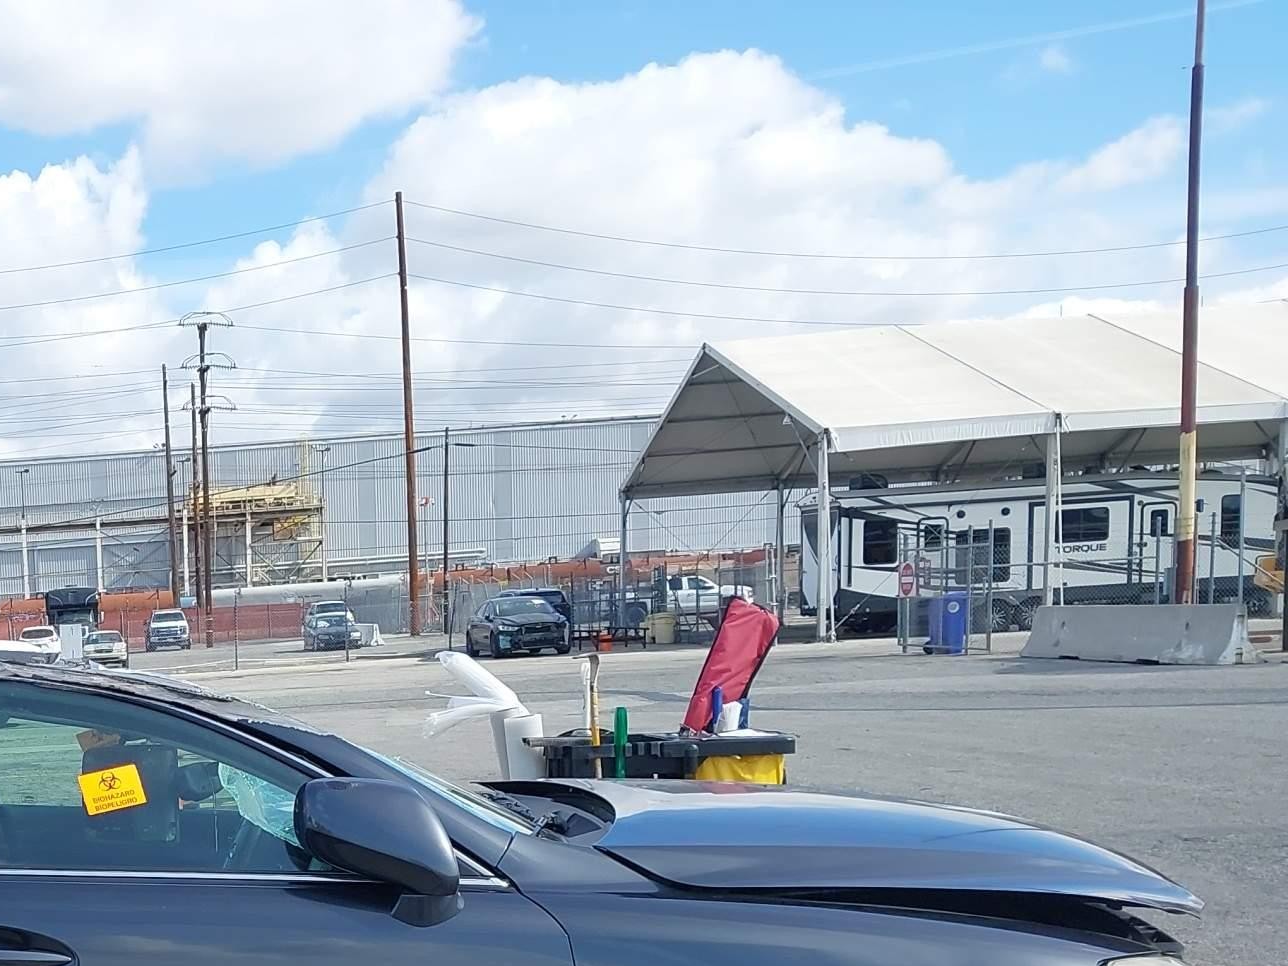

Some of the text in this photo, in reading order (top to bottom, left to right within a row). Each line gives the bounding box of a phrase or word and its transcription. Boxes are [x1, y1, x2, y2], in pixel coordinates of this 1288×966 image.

[1054, 543, 1107, 554] TORQUE
[92, 789, 135, 804] BIOHAZARD
[94, 797, 138, 811] BIOPELIGRO
